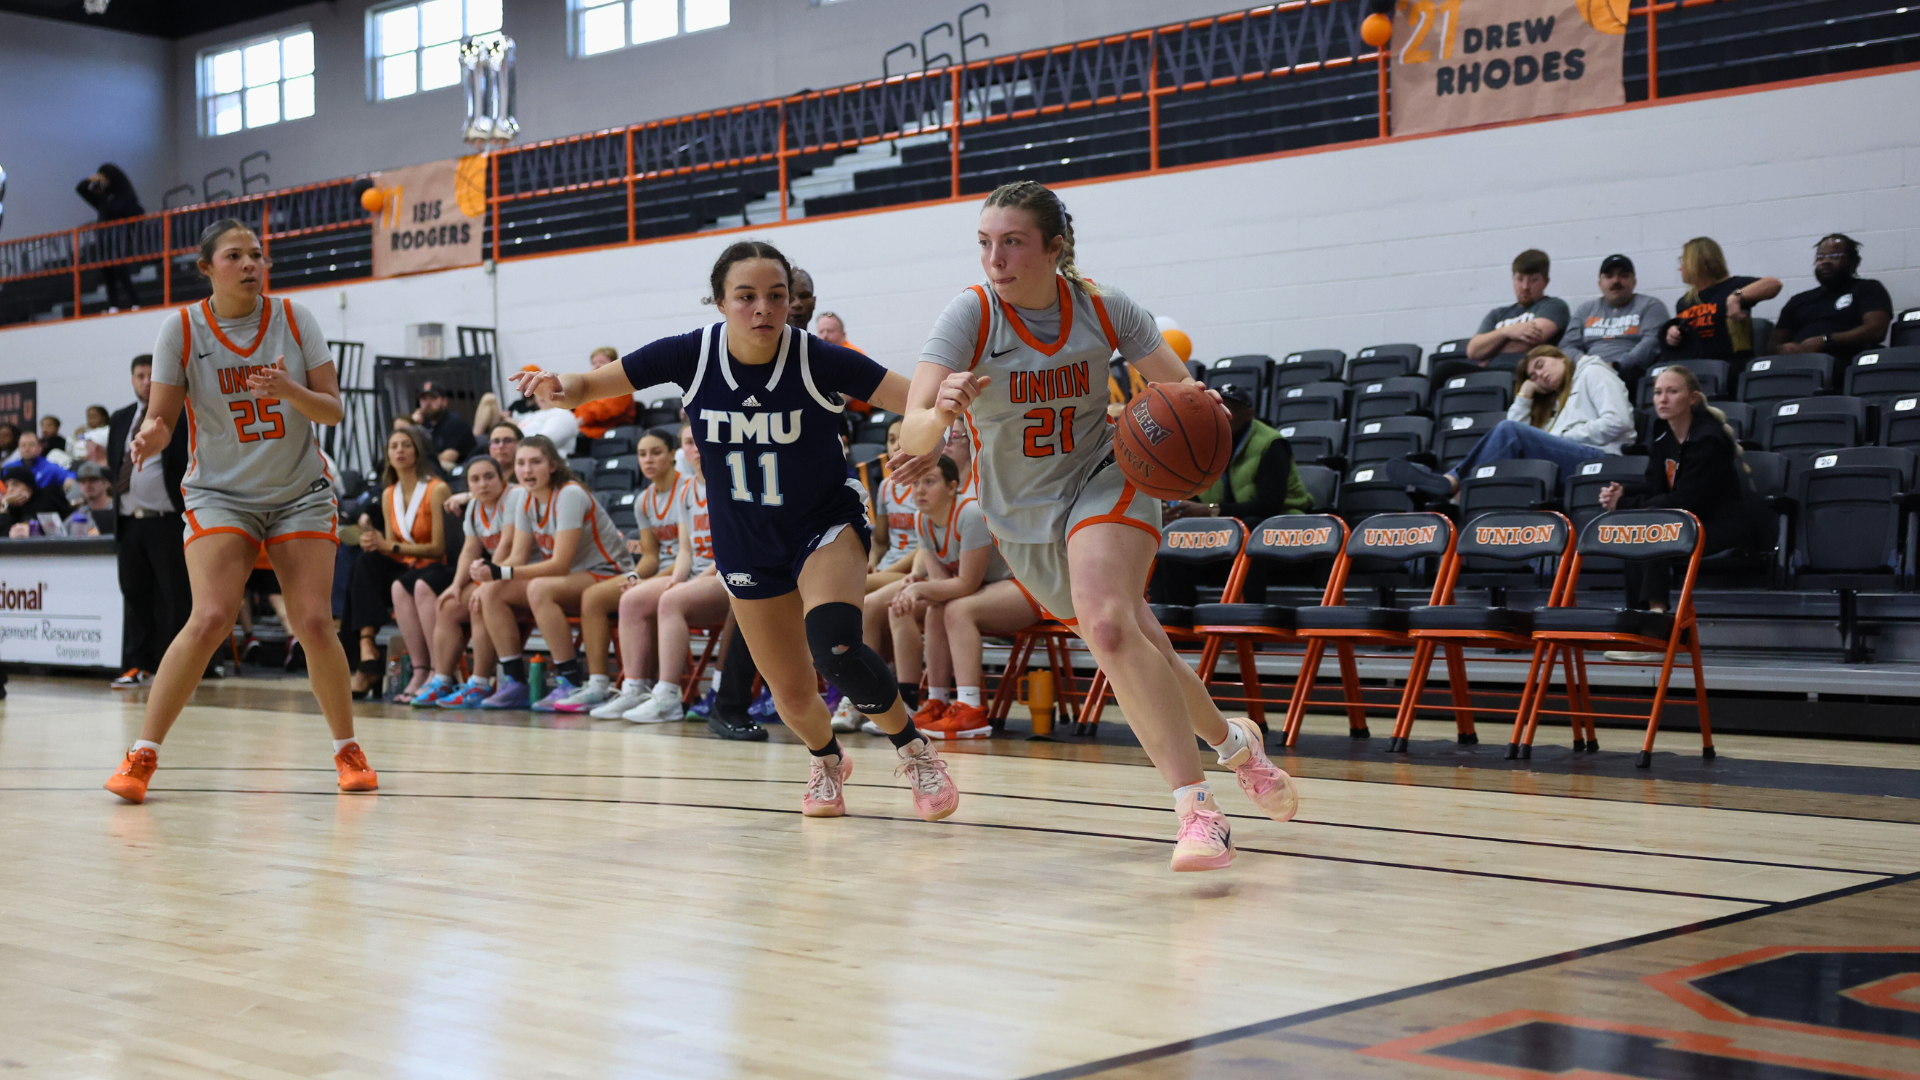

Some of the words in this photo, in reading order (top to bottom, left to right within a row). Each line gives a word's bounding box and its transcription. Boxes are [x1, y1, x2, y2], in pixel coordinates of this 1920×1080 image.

[1463, 15, 1555, 53] DREW
[1436, 48, 1586, 96] RHODES
[412, 198, 442, 223] ISIS
[391, 223, 470, 252] RODGERS
[1010, 361, 1089, 403] UNION
[229, 398, 285, 443] 25
[699, 408, 804, 445] TMU
[1023, 406, 1076, 458] 21
[1131, 395, 1174, 447] NAIA
[1115, 426, 1154, 478] SPALD
[725, 451, 784, 507] 11
[1168, 530, 1233, 548] UNION
[1263, 527, 1332, 546] UNION
[1364, 525, 1438, 546] UNION
[1476, 525, 1555, 545] UNION
[1598, 523, 1683, 543] UNION
[0, 582, 42, 610] ional
[41, 619, 102, 642] Resources
[56, 644, 99, 659] Corporation
